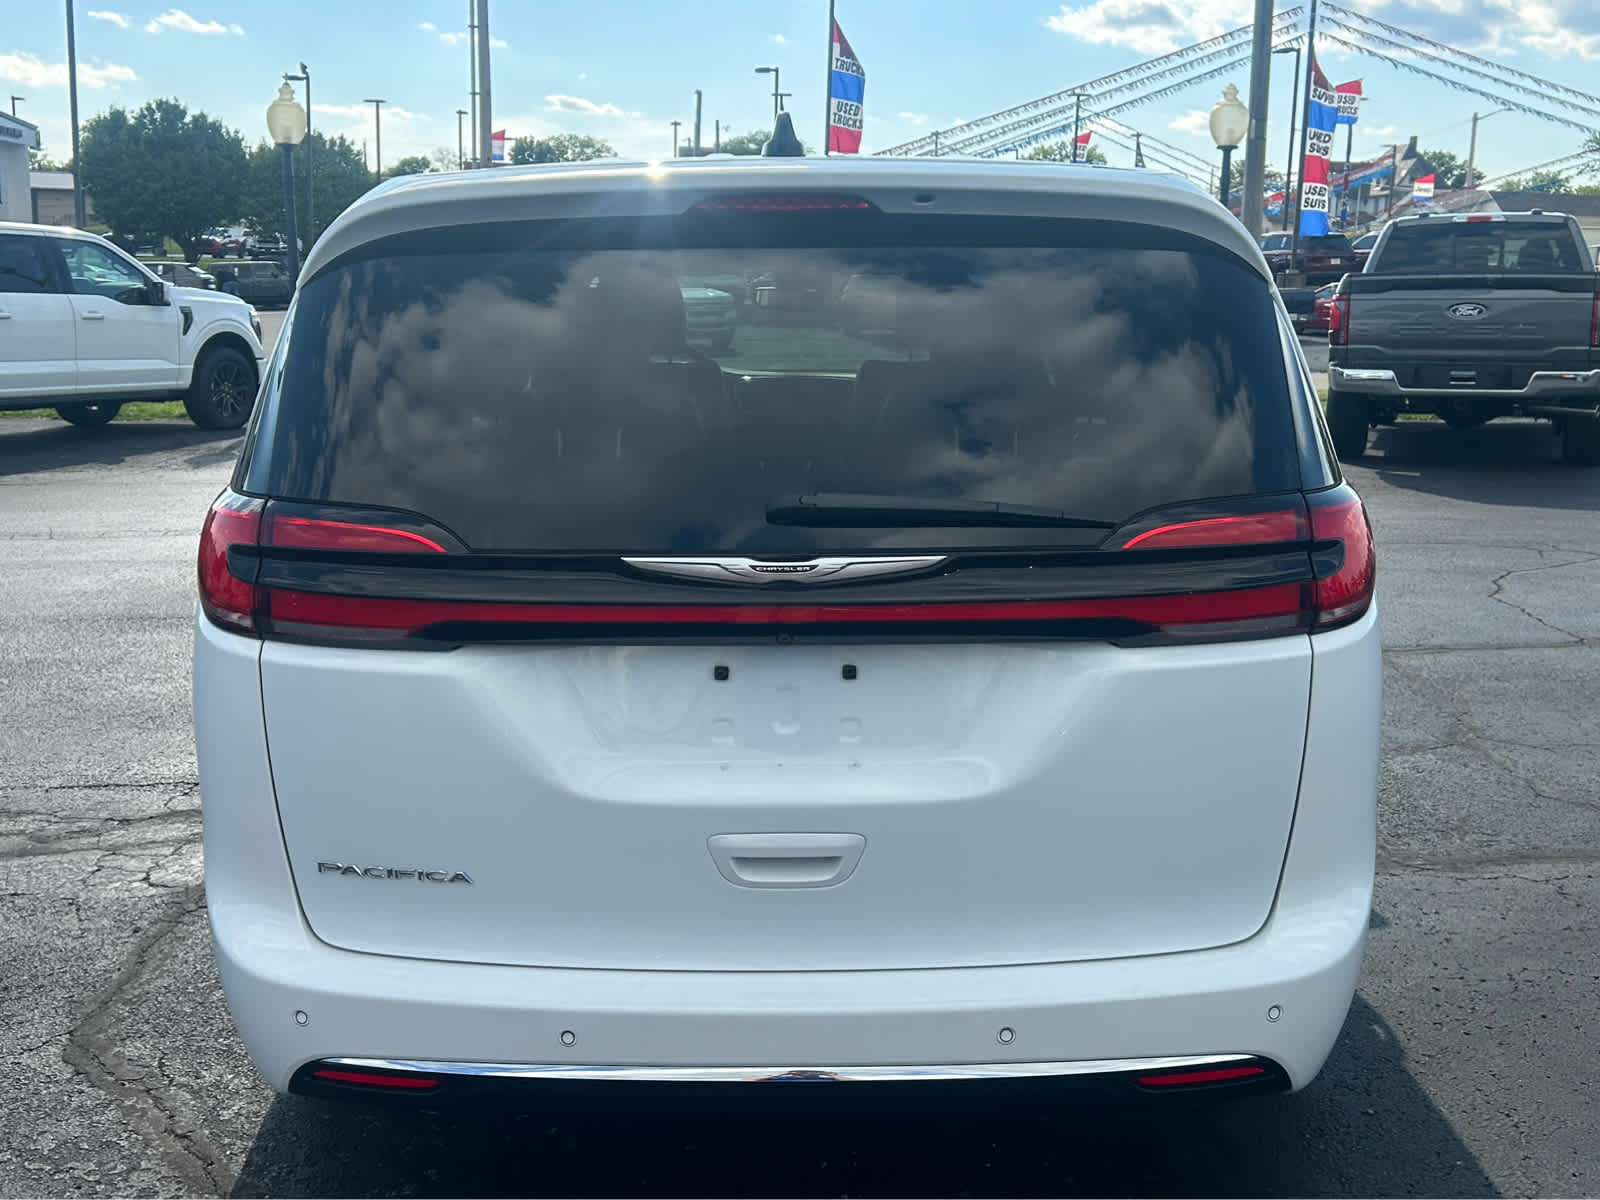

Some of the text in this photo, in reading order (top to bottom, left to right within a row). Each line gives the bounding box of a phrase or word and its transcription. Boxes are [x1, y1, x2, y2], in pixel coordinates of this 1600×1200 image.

[836, 100, 860, 116] USED
[832, 112, 863, 130] TRUCKS
[1304, 184, 1327, 197] USED
[316, 861, 474, 885] PACIFICA
